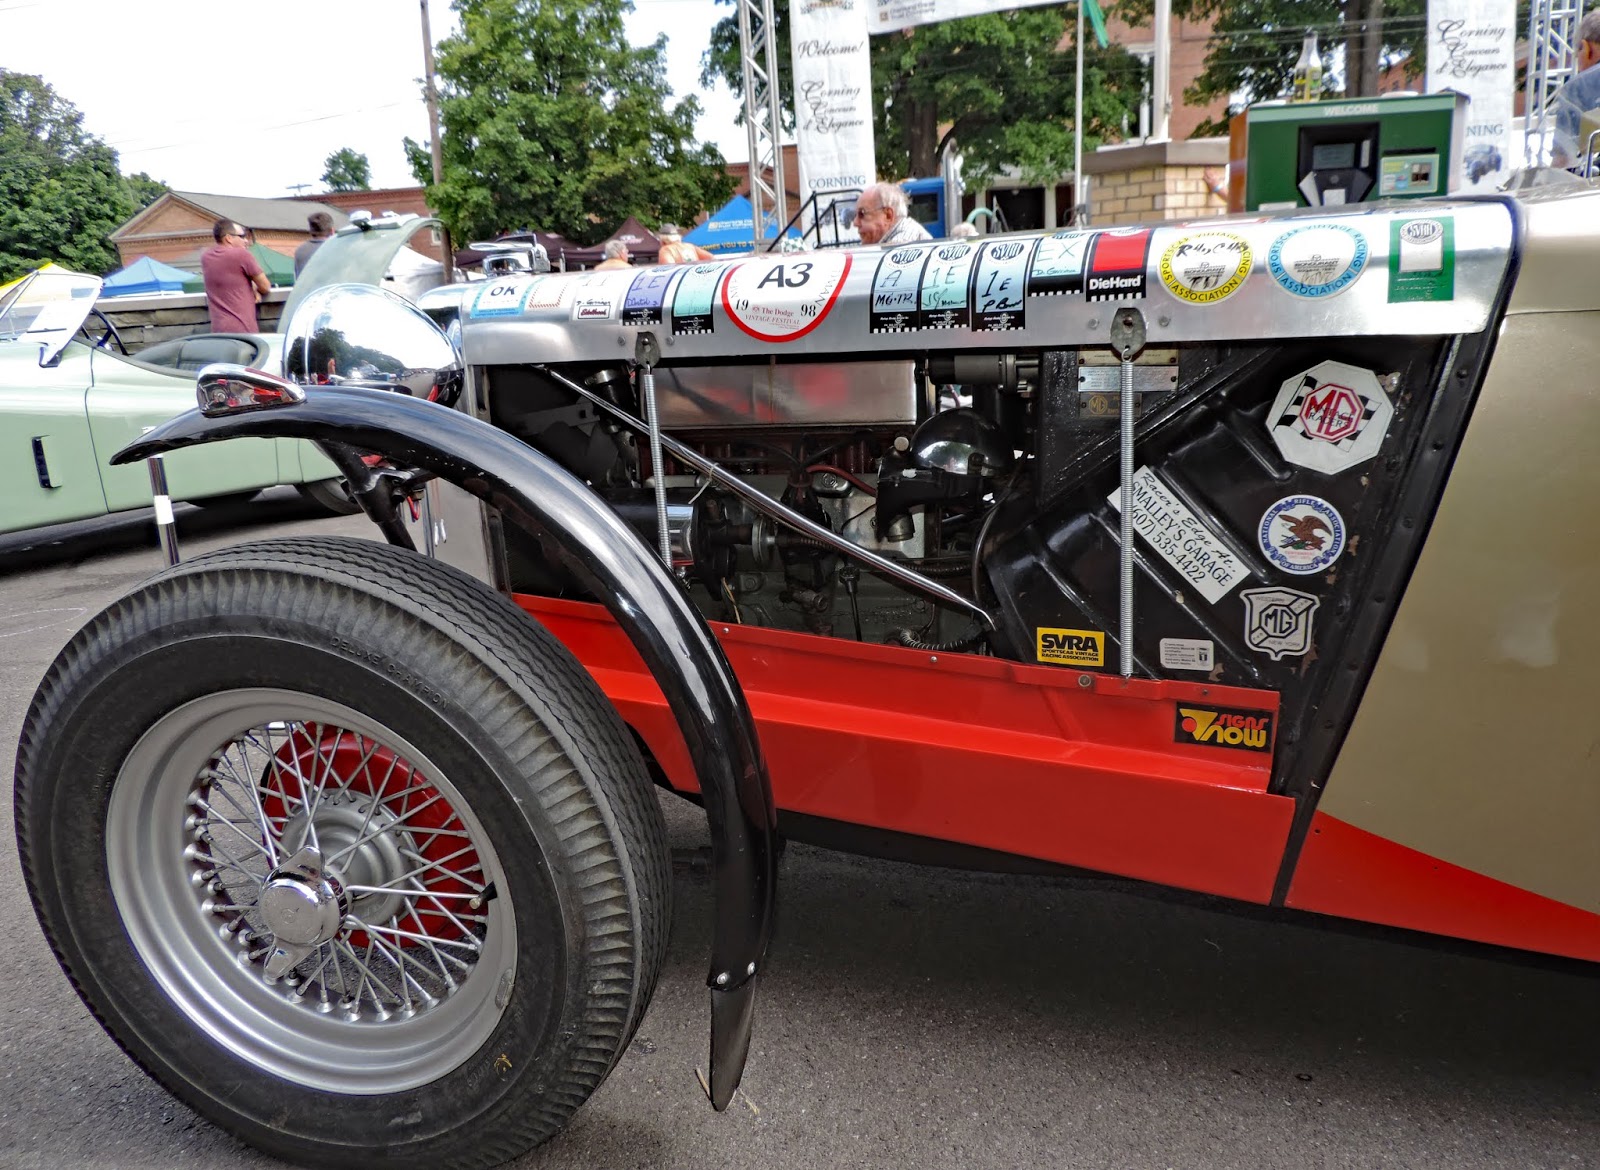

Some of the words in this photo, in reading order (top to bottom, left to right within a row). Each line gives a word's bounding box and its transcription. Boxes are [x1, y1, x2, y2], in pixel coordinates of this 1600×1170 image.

[1437, 20, 1505, 44] Corning
[798, 40, 864, 58] Welcome!
[801, 81, 861, 103] Corning
[1324, 104, 1379, 115] WELCOME
[808, 175, 866, 189] CORNING
[1353, 233, 1365, 268] RACING
[757, 262, 814, 289] A3
[1089, 274, 1142, 290] DieHard
[1280, 272, 1351, 296] ASSOCIATION
[490, 285, 518, 297] OK
[1172, 280, 1238, 302] ASSOCIATION
[735, 299, 749, 311] 19
[762, 307, 774, 315] The
[774, 308, 795, 317] Dodge
[800, 304, 817, 317] 98
[745, 314, 772, 322] VINTAGE
[771, 316, 800, 325] FESTIVAL
[1182, 517, 1211, 546] Edge
[1262, 509, 1279, 543] NATIONAL
[1294, 498, 1316, 506] RIFLE
[1324, 509, 1341, 554] ASSOCIATION
[1152, 531, 1206, 584] 535-4422
[1183, 539, 1233, 587] GARAGE
[1290, 563, 1319, 571] AMERICA
[1265, 608, 1293, 634] MG
[330, 636, 381, 666] DELUXE
[1041, 633, 1099, 652] SVRA
